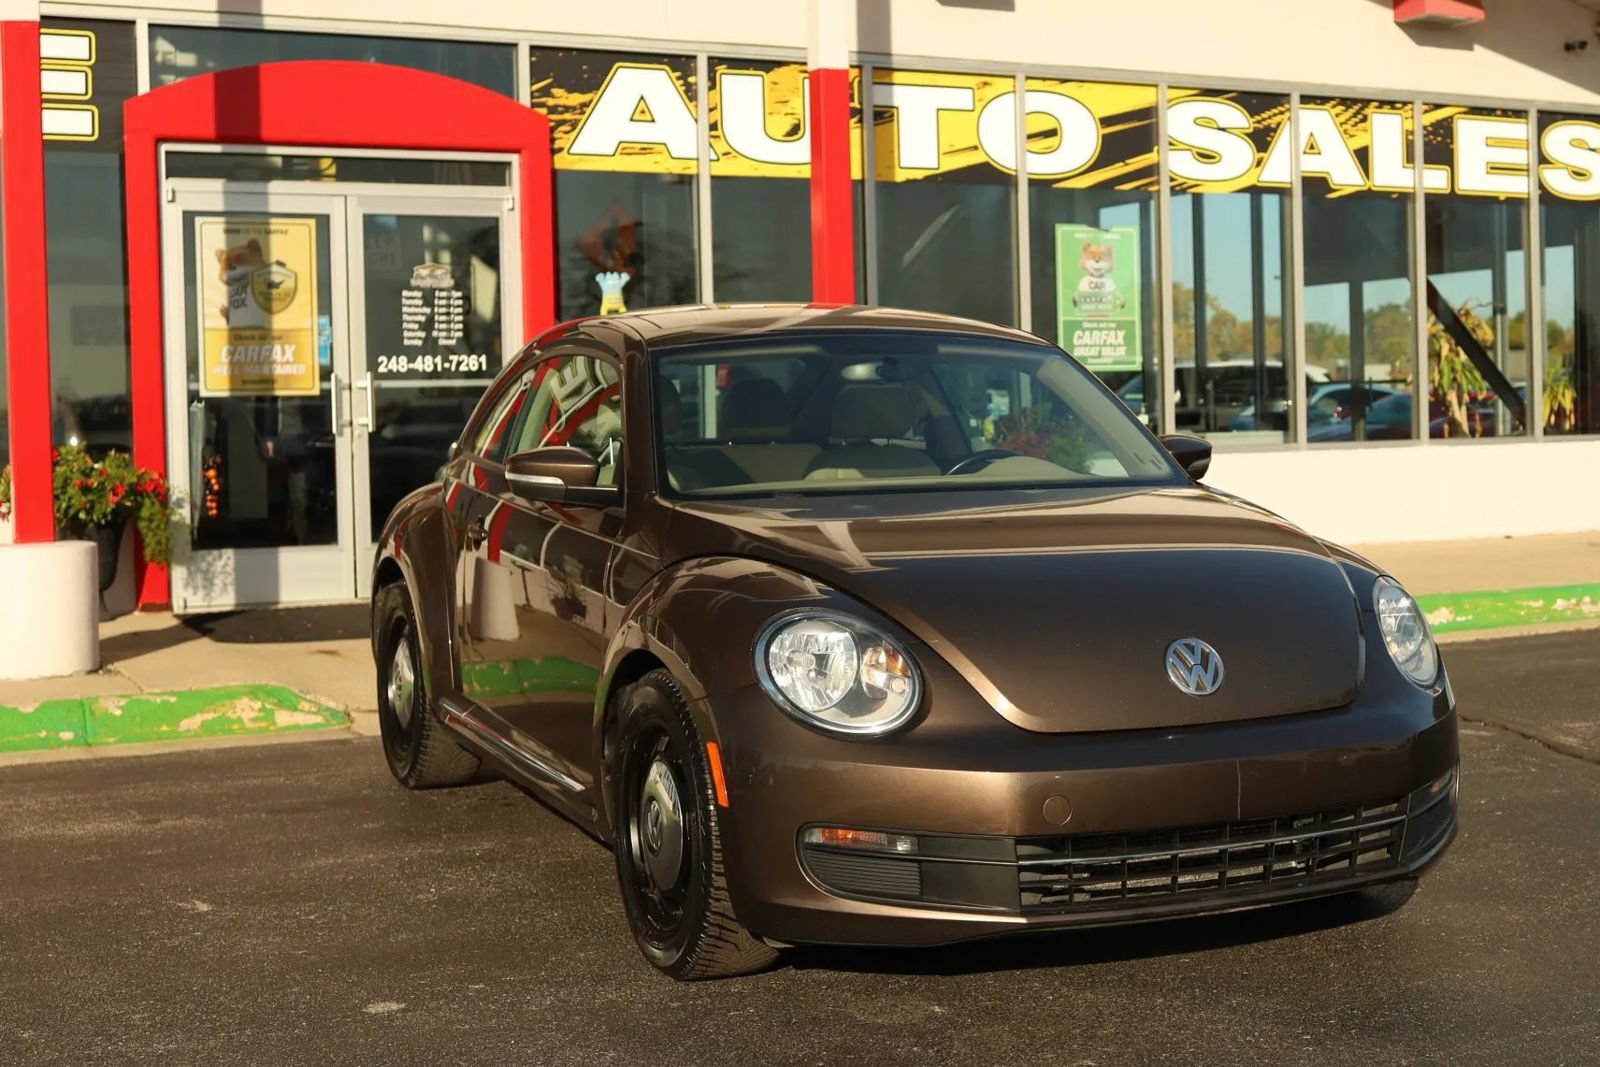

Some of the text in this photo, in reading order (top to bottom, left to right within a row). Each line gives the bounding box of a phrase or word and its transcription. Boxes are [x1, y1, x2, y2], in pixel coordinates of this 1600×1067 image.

[566, 62, 1101, 178] AUTO
[1166, 97, 1600, 200] SALES
[1073, 330, 1126, 346] CARFAX
[220, 344, 297, 363] CARFAX
[377, 353, 487, 373] 248-481-7261
